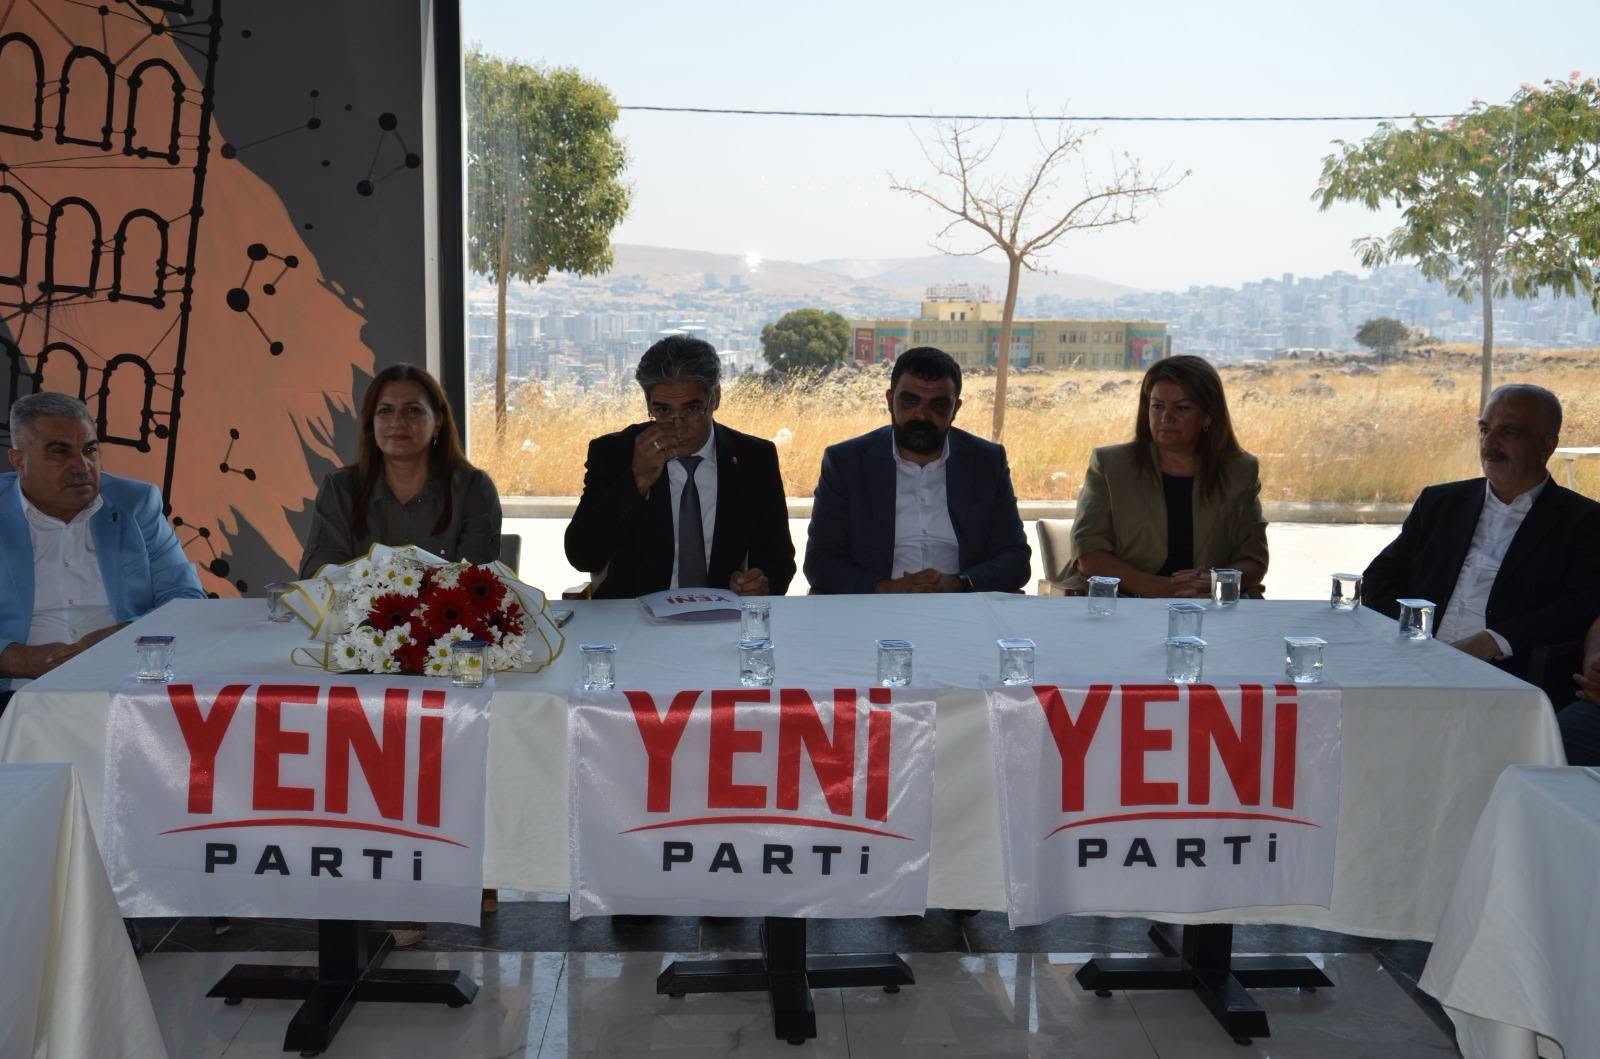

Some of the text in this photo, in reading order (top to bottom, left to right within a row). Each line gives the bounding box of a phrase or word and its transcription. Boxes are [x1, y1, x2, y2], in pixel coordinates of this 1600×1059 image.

[167, 684, 446, 828] YENİ
[622, 688, 892, 823] YENİ
[1032, 684, 1298, 813] YENİ
[205, 842, 423, 881] PARTİ
[662, 841, 870, 876] PARTİ
[1078, 833, 1278, 868] PARTİ
